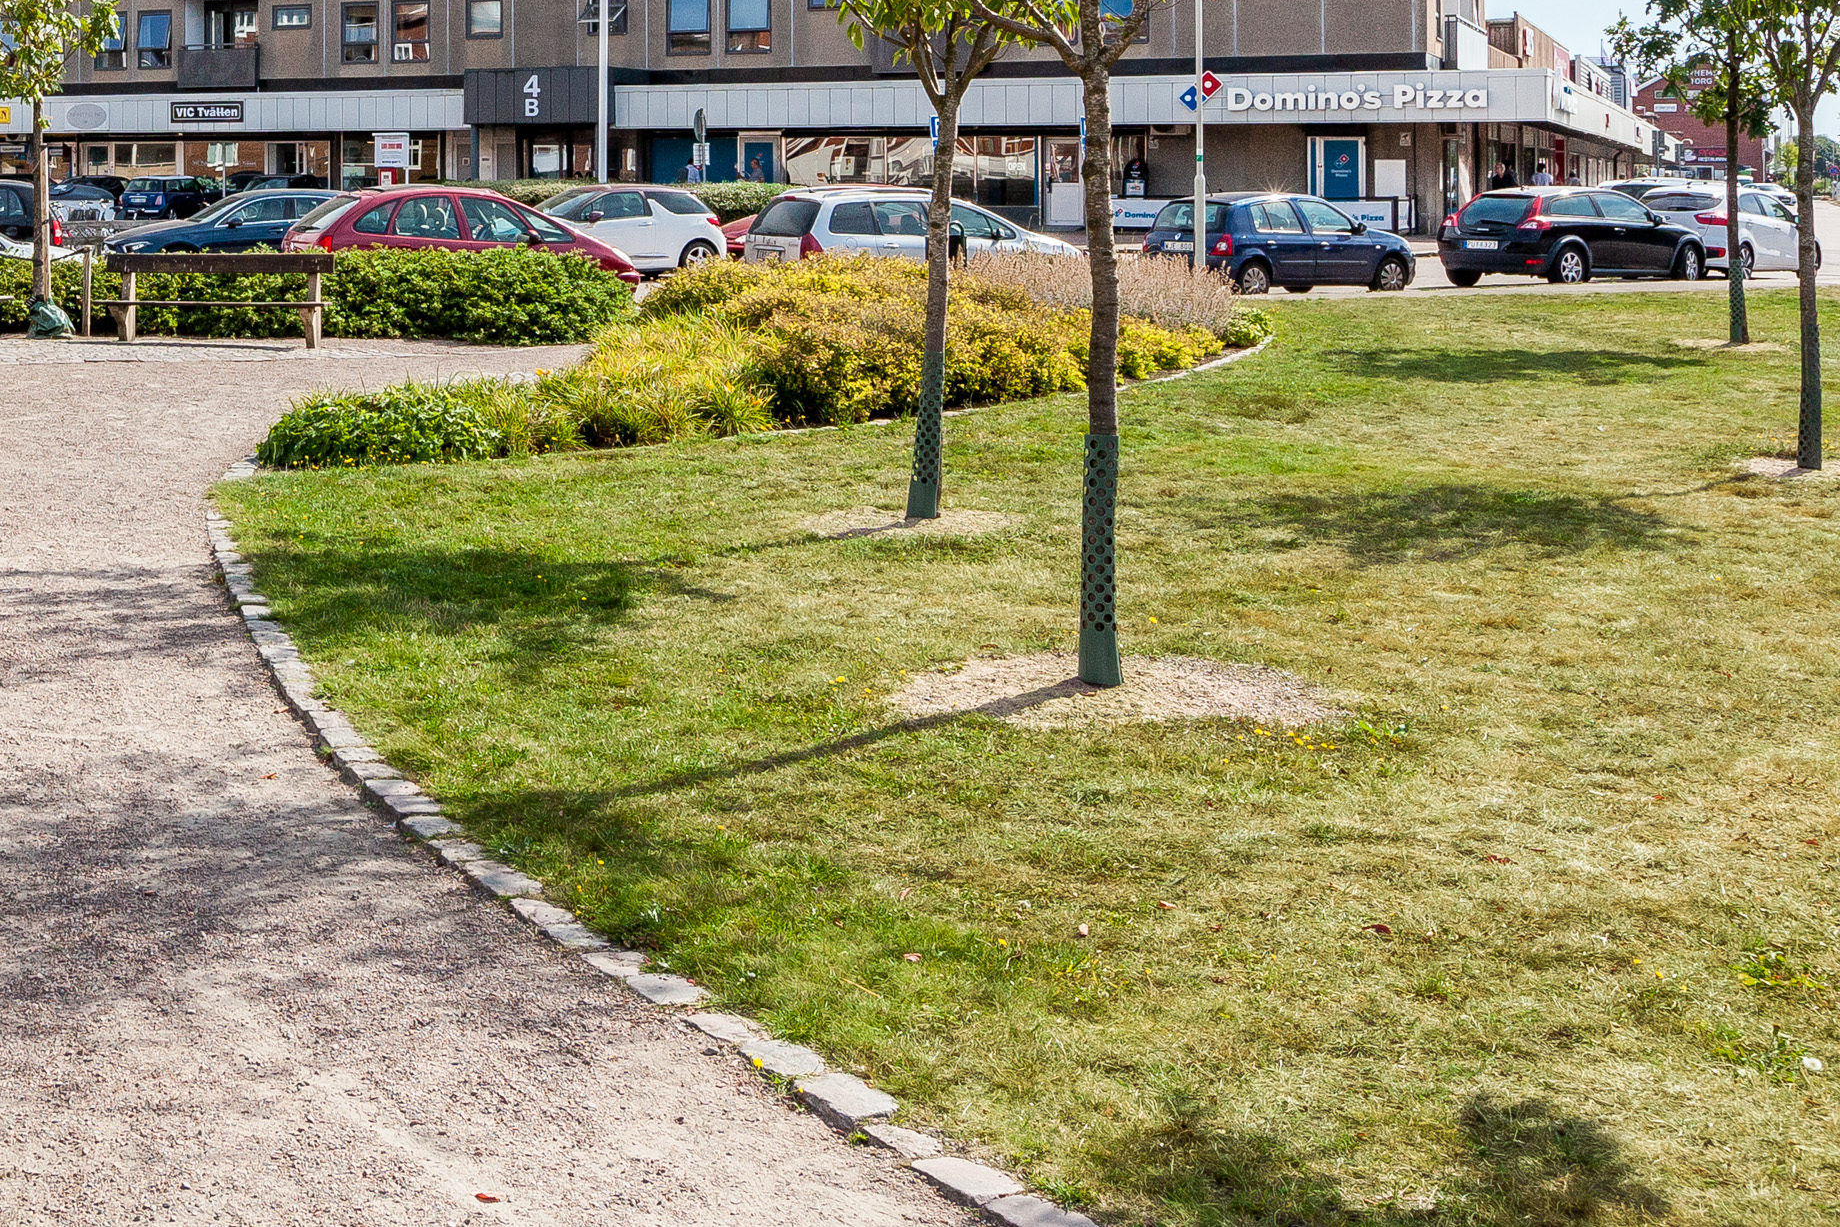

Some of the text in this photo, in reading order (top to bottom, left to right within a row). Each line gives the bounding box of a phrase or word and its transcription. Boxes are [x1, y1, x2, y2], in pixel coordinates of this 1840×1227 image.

[523, 74, 541, 97] 4
[1227, 82, 1488, 112] Domino's Pizza
[175, 106, 239, 118] VIC Tvätten
[525, 98, 539, 117] B
[1007, 162, 1026, 171] OPEN
[1124, 211, 1158, 220] Domino'
